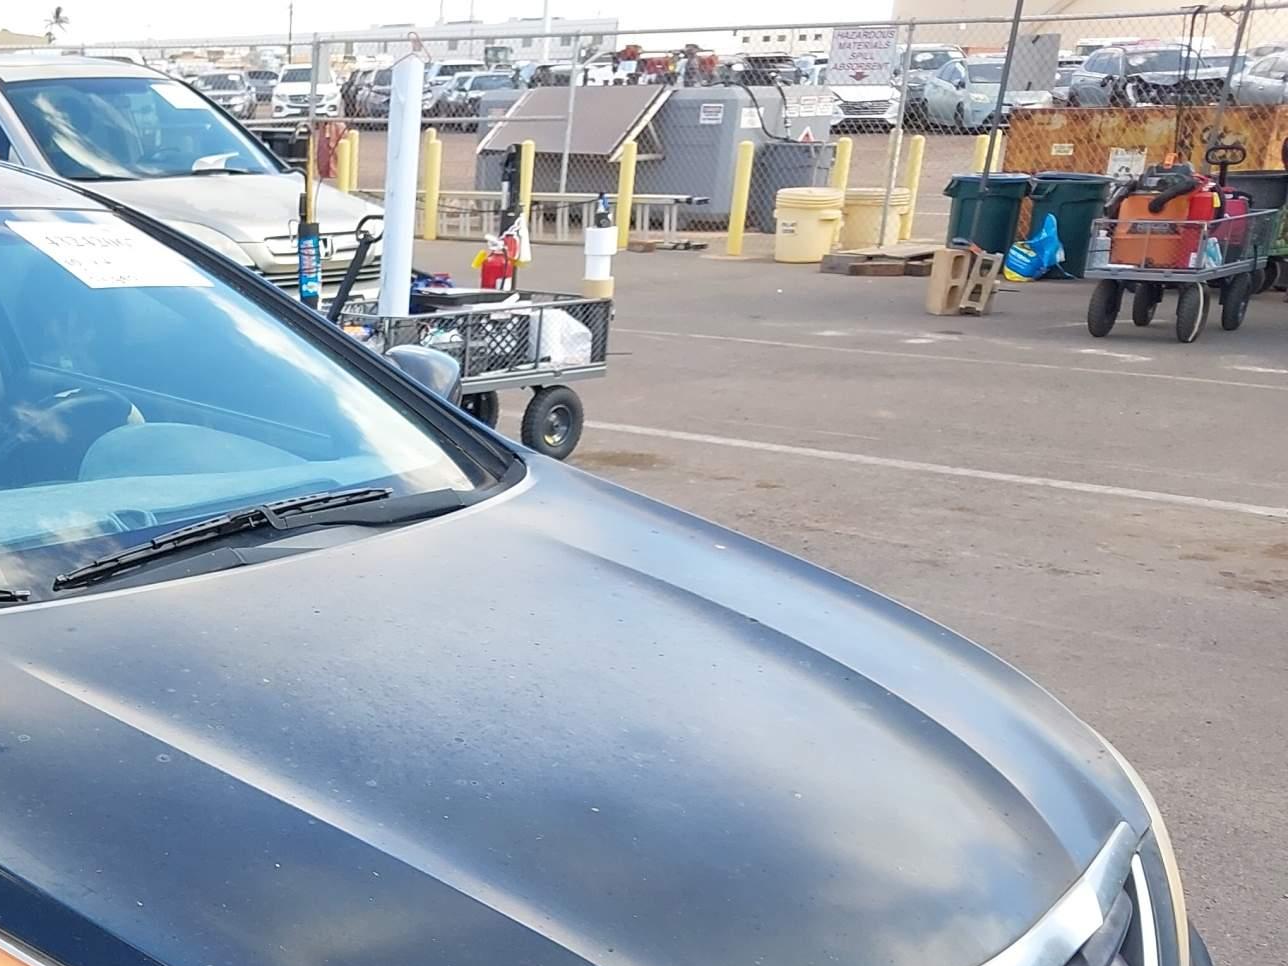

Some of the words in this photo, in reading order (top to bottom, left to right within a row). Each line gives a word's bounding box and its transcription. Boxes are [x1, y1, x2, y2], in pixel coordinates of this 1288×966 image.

[837, 30, 895, 40] HAZARDOUS
[837, 40, 891, 50] MATERIALS
[848, 51, 874, 60] SPILL
